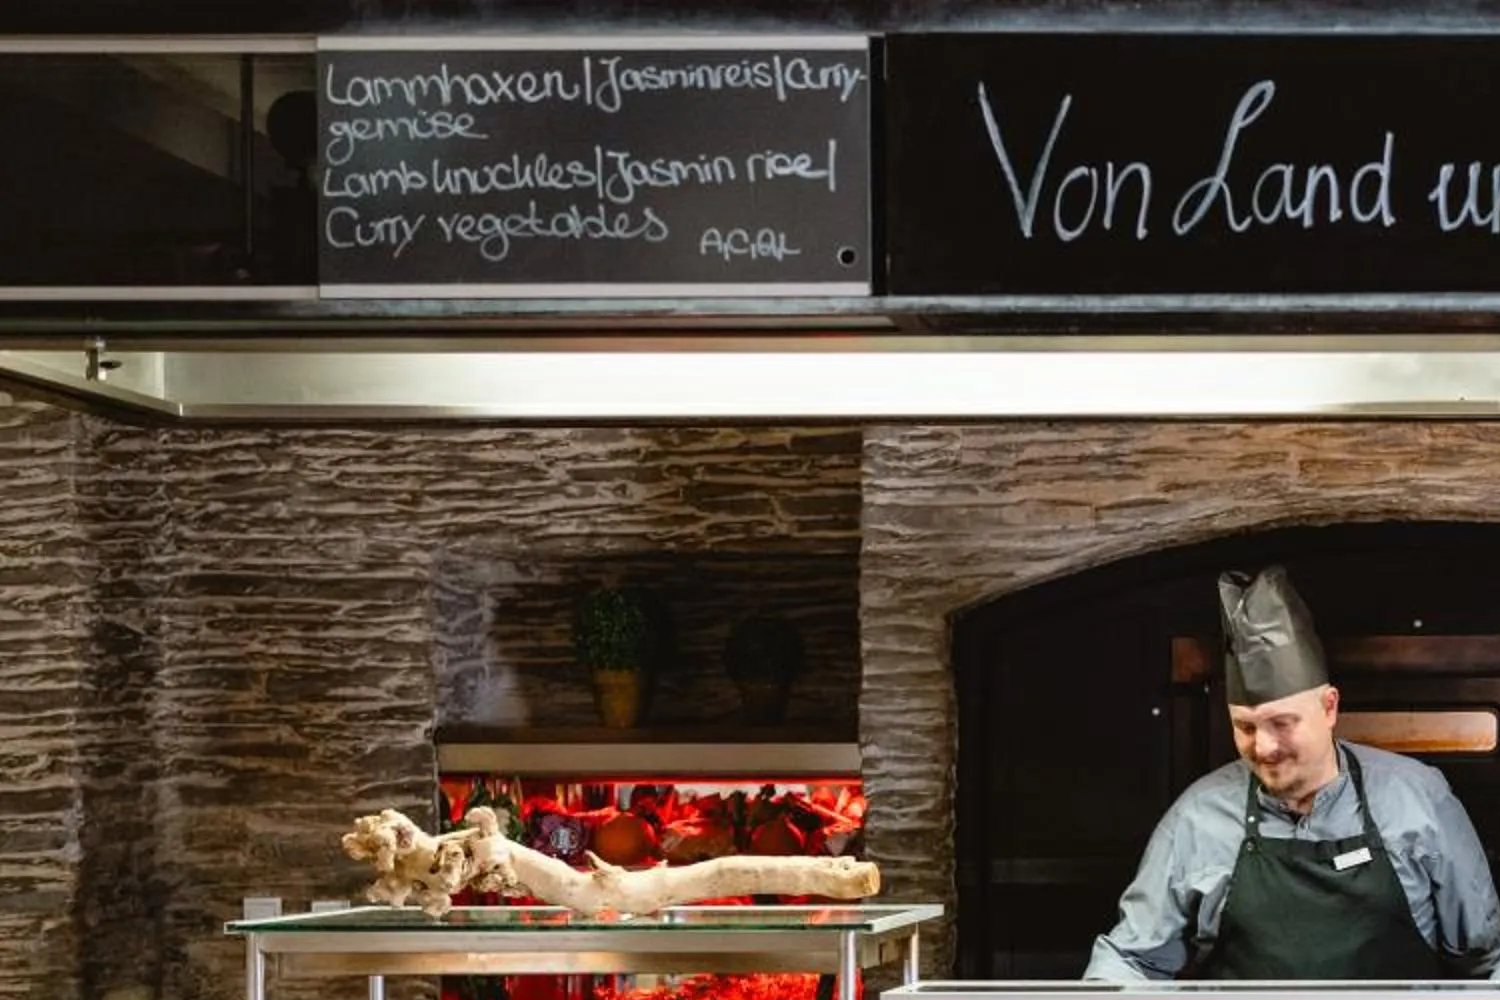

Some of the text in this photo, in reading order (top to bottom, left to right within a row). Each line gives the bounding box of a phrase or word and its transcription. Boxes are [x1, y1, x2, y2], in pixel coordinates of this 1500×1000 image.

[325, 110, 489, 166] gemüse
[978, 82, 1150, 241] Von
[1171, 80, 1397, 234] Land
[323, 159, 428, 199] Lamb
[325, 199, 669, 262] Curry vegetables
